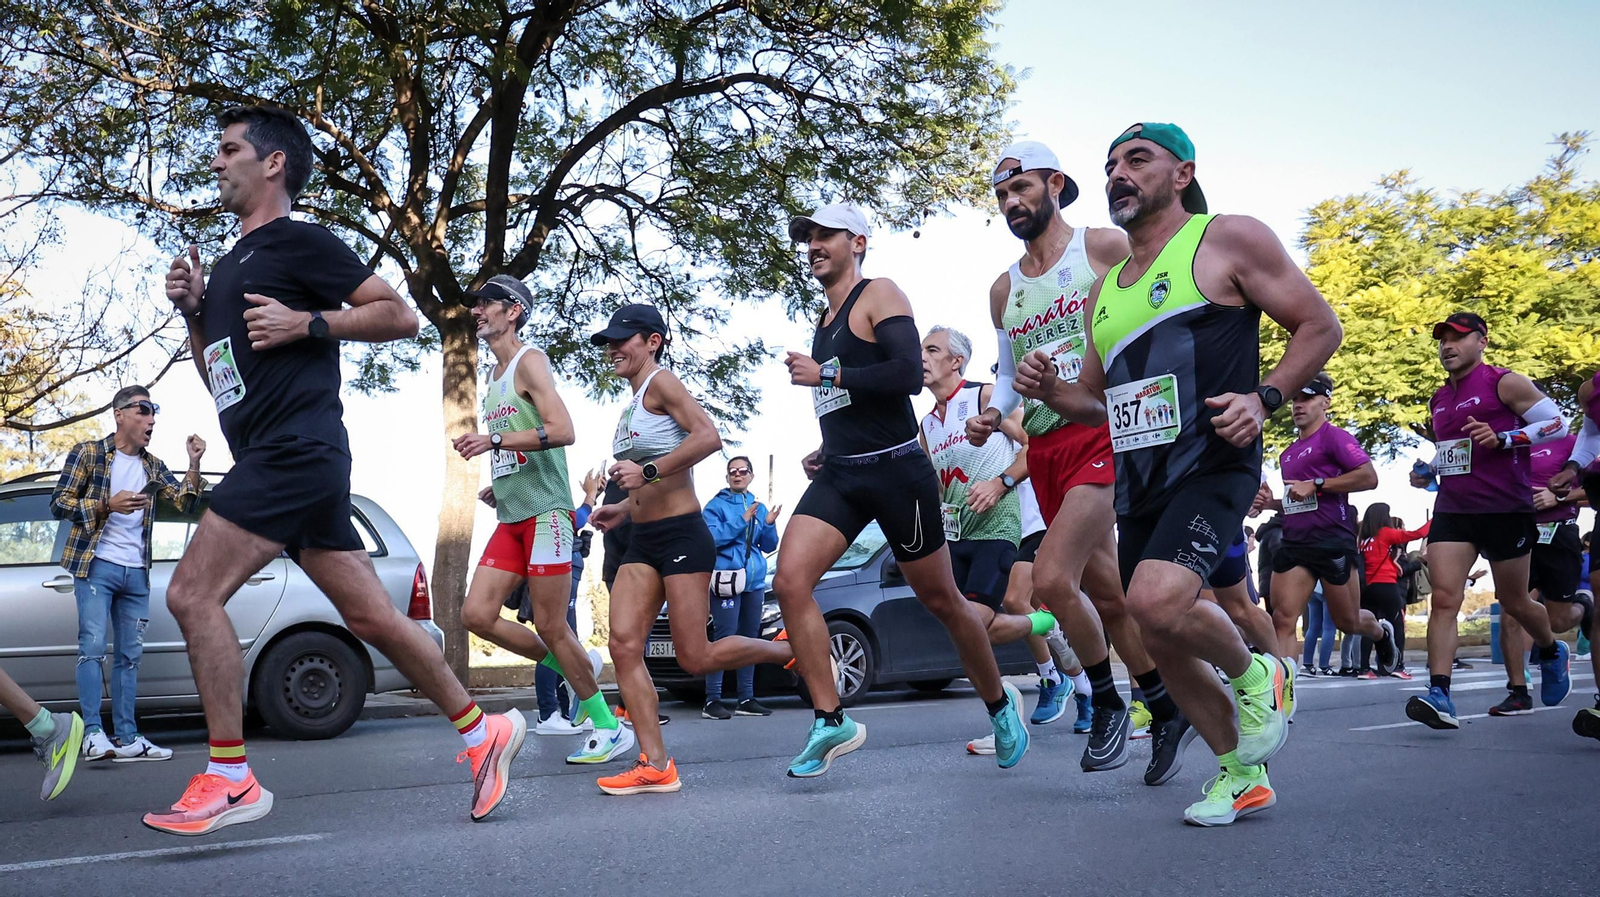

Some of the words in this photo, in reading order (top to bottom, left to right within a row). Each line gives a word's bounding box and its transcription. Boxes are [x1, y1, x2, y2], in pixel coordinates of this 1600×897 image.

[1155, 271, 1169, 280] JSR
[1025, 319, 1078, 349] JEREZ
[1113, 399, 1142, 430] 357
[651, 643, 670, 656] 2631
